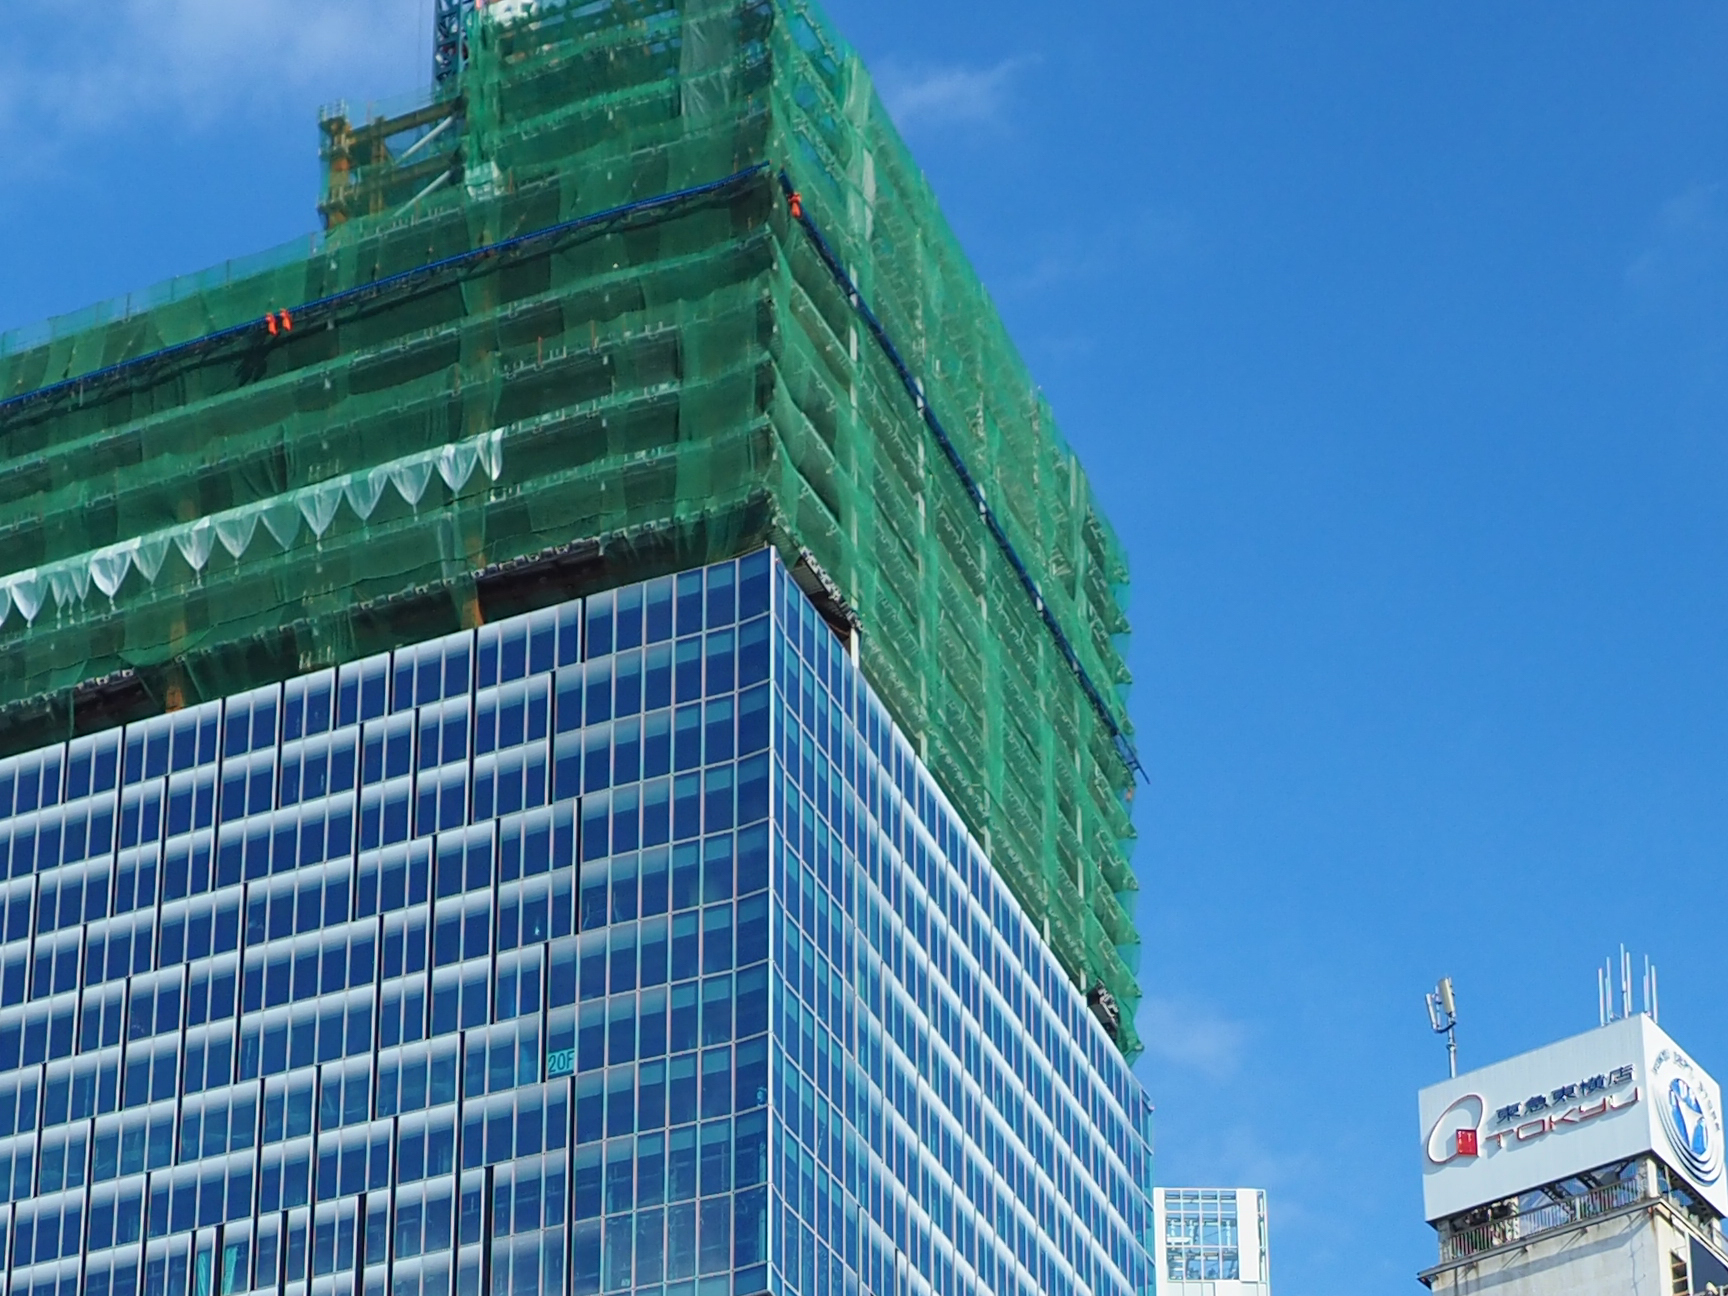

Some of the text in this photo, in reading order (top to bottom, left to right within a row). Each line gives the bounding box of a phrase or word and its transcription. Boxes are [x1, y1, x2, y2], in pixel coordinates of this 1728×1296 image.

[1485, 1087, 1642, 1151] TOKYU
[1496, 1063, 1635, 1125] 東急東横店
